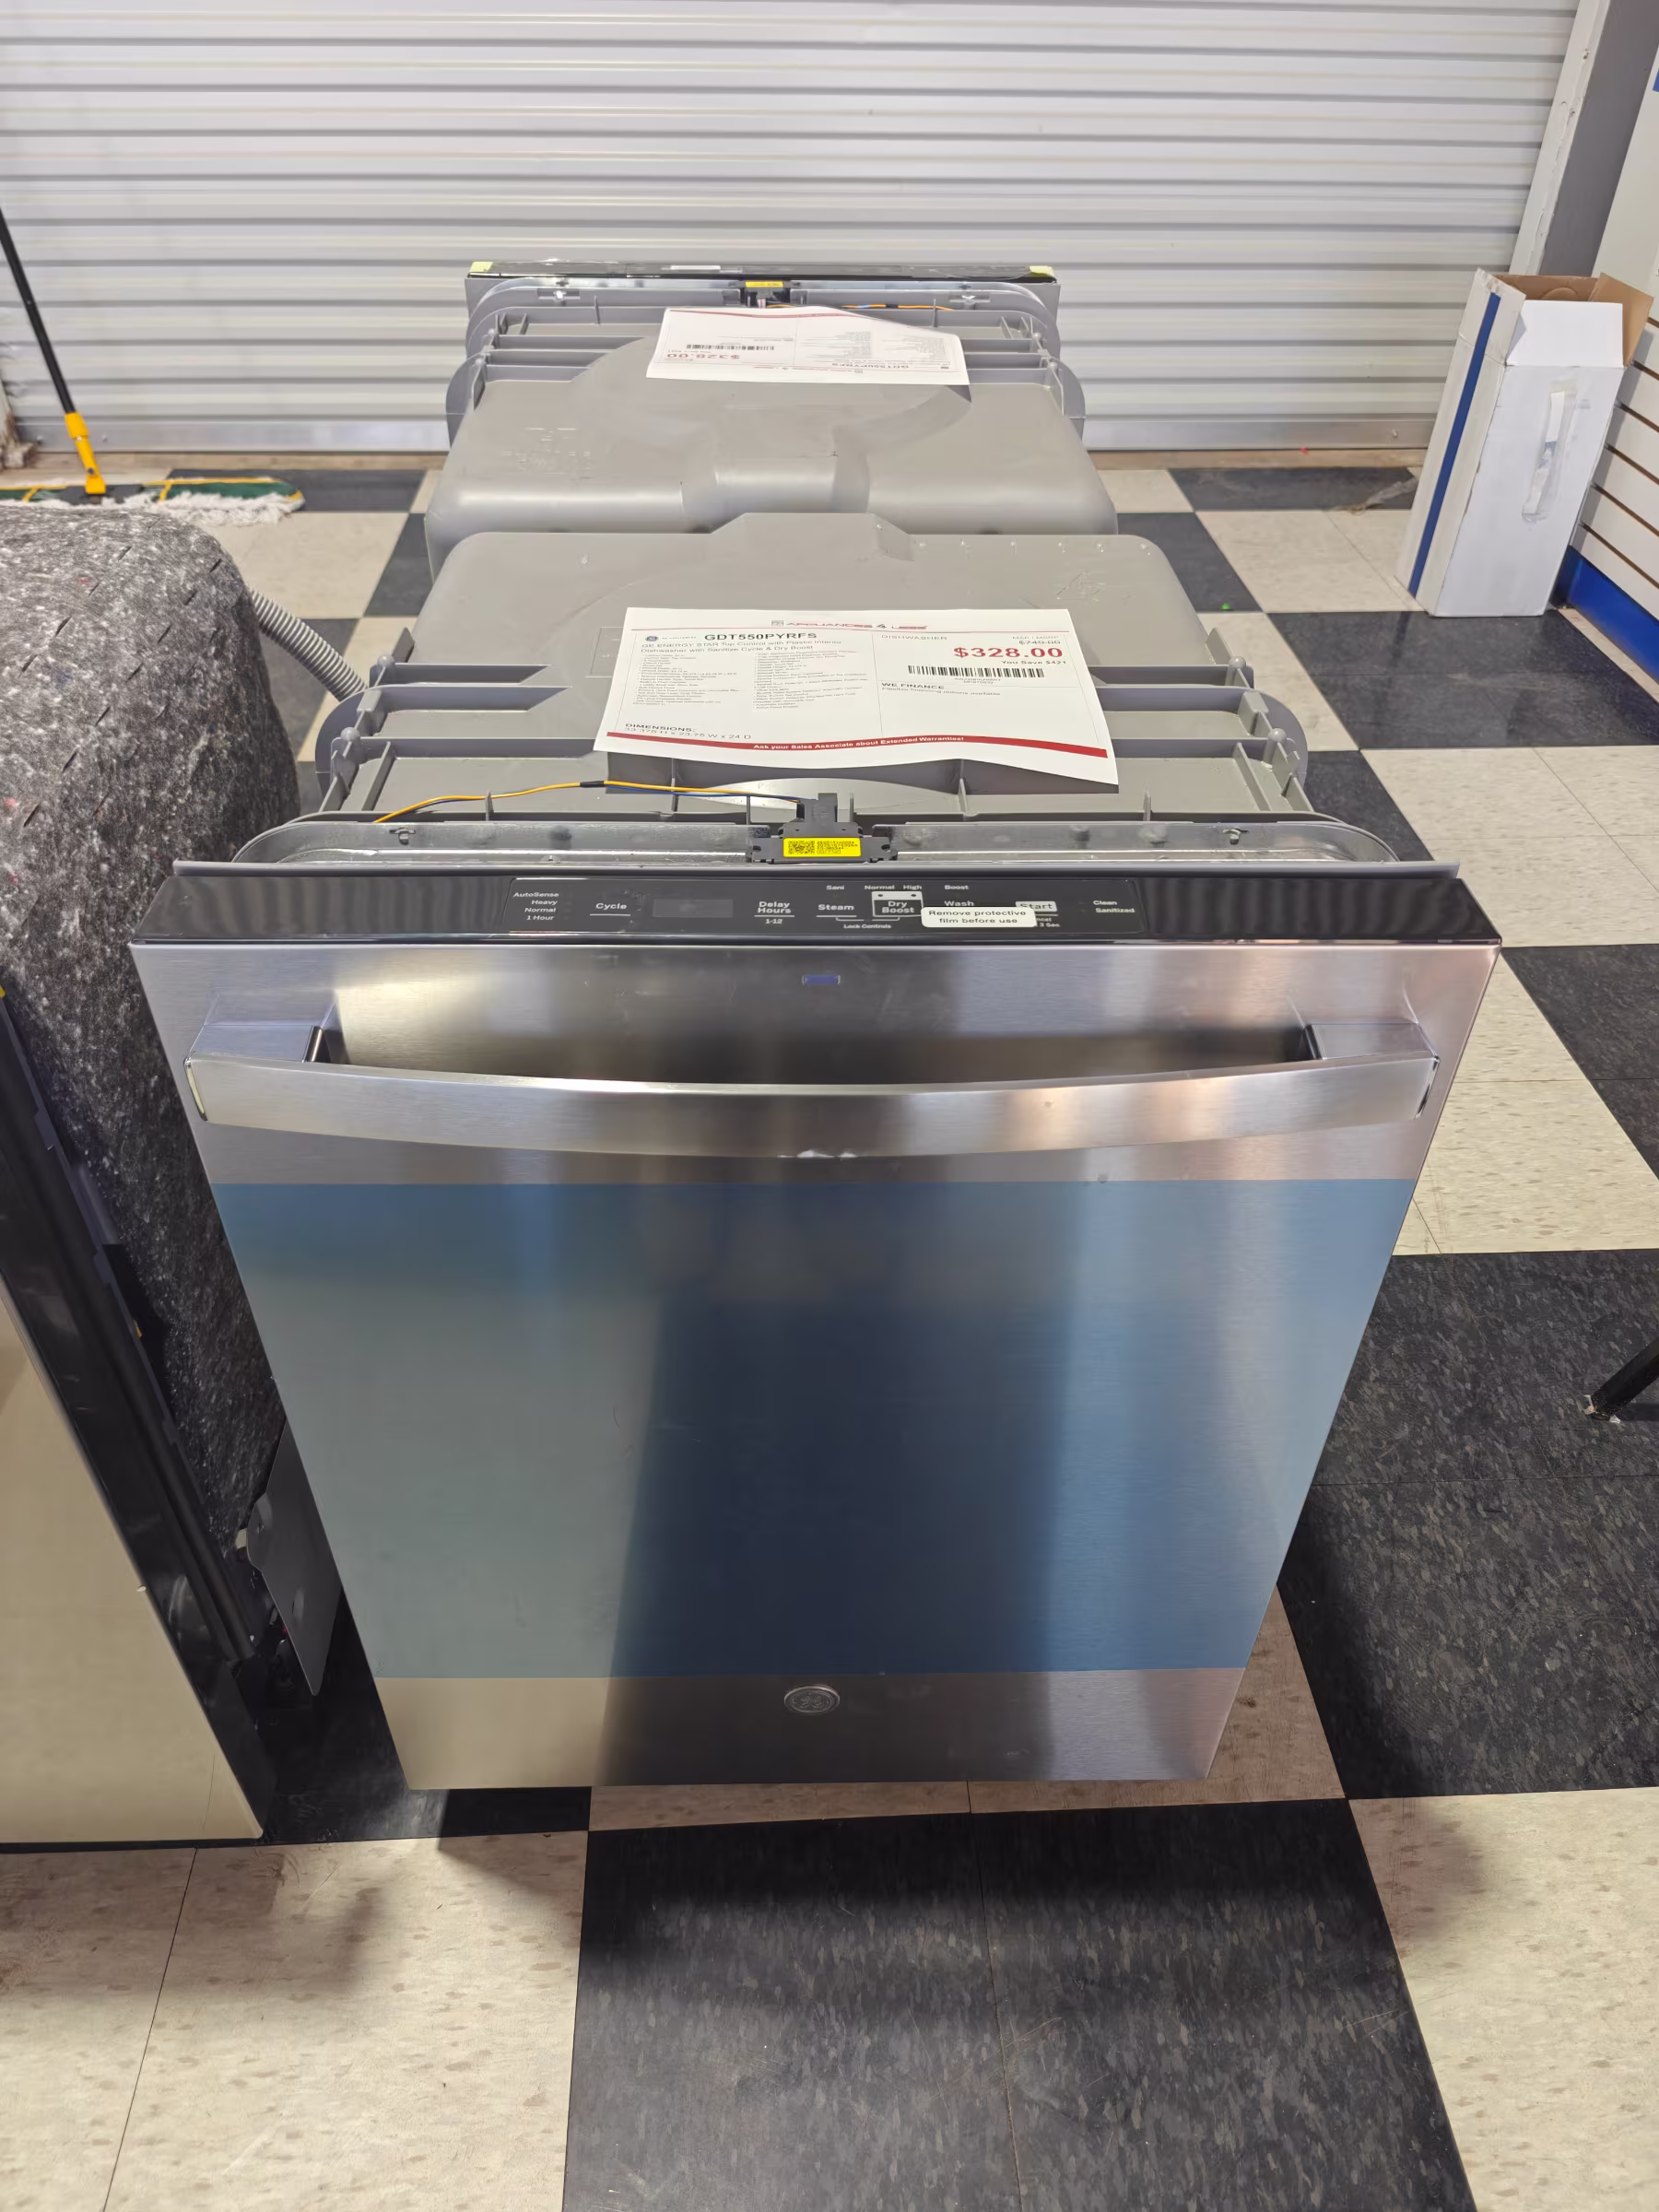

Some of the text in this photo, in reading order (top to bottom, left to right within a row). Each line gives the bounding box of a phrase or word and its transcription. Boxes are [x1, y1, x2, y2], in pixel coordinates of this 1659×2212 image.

[704, 632, 818, 641] GDT550PYRFS
[953, 647, 1064, 658] $328.00
[759, 900, 791, 909] Delay
[888, 900, 908, 909] Dry
[974, 910, 1027, 918] protective
